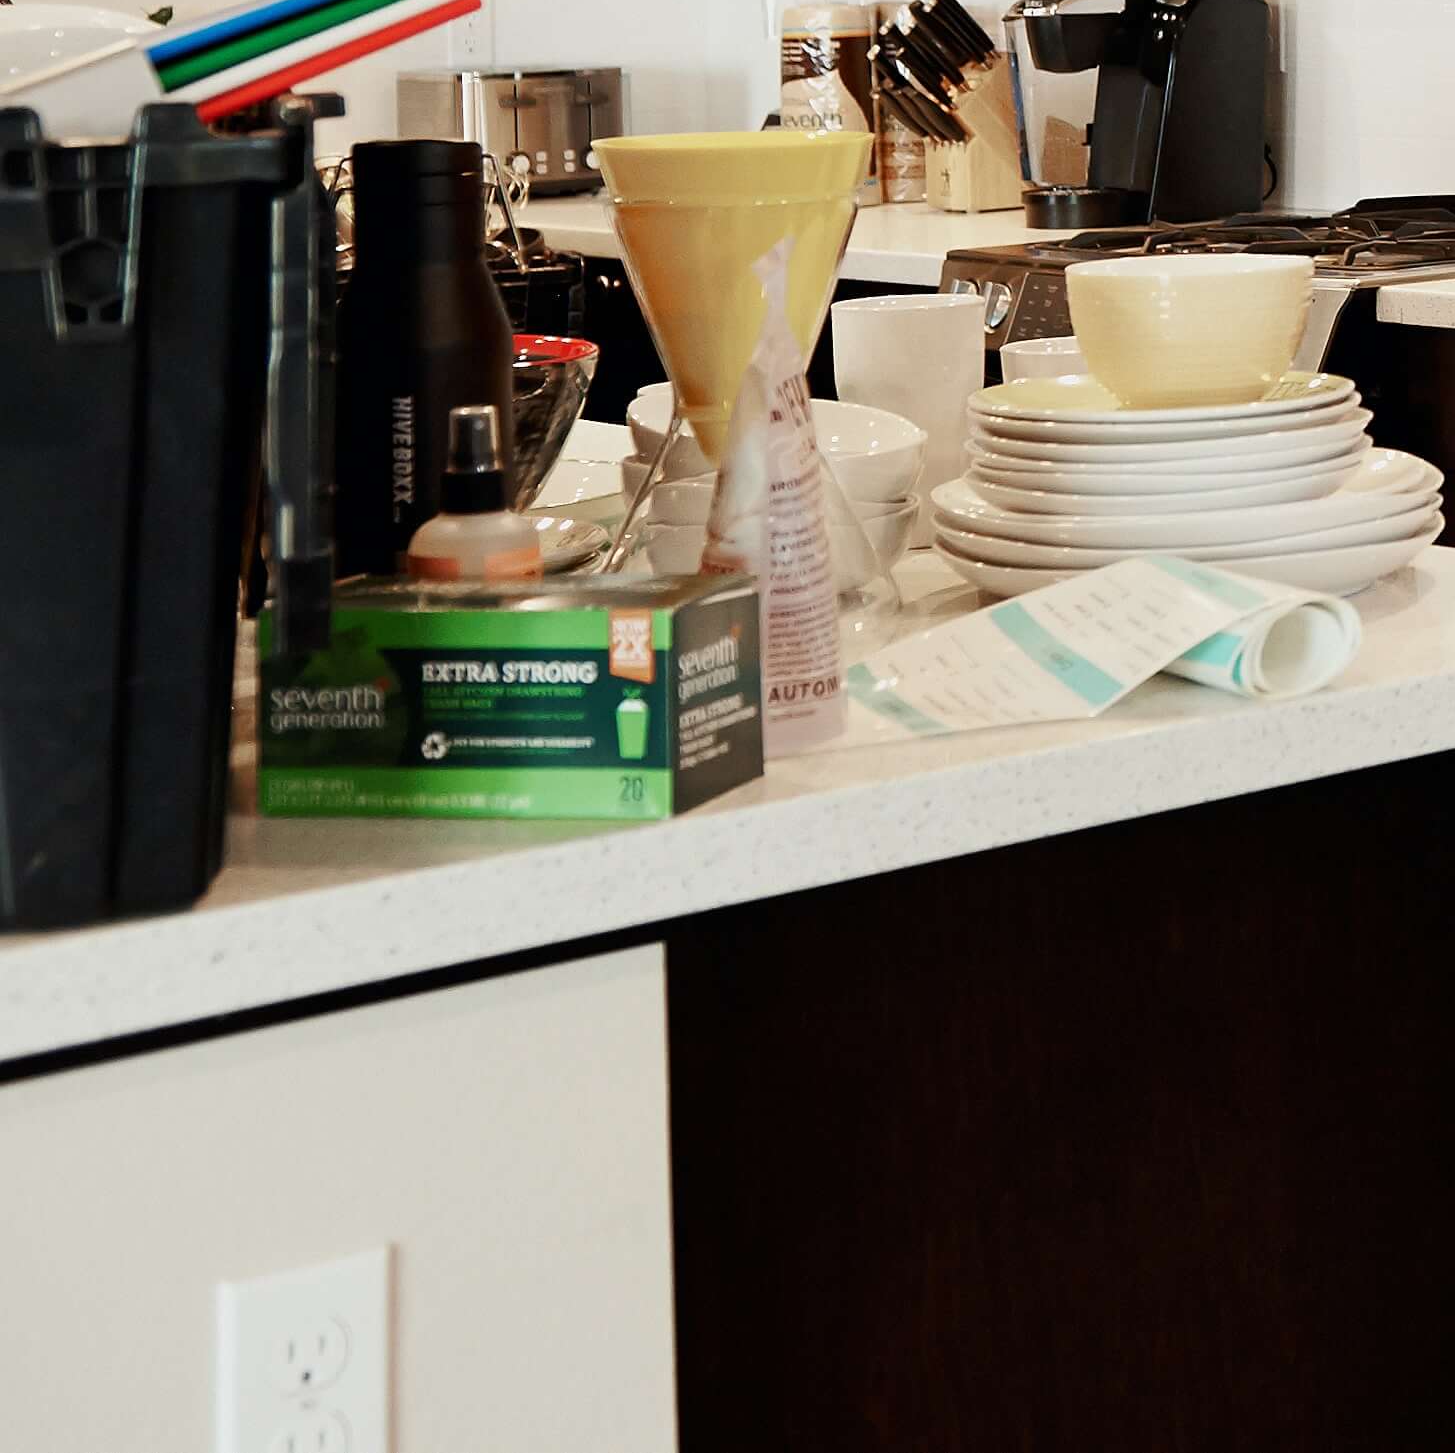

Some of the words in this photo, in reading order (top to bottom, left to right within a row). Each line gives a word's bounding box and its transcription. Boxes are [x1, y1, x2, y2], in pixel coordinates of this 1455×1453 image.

[422, 661, 499, 683] EXTRA
[502, 661, 598, 685] STRONG
[271, 685, 385, 710] seventh
[271, 710, 385, 734] generation
[620, 775, 644, 801] 20
